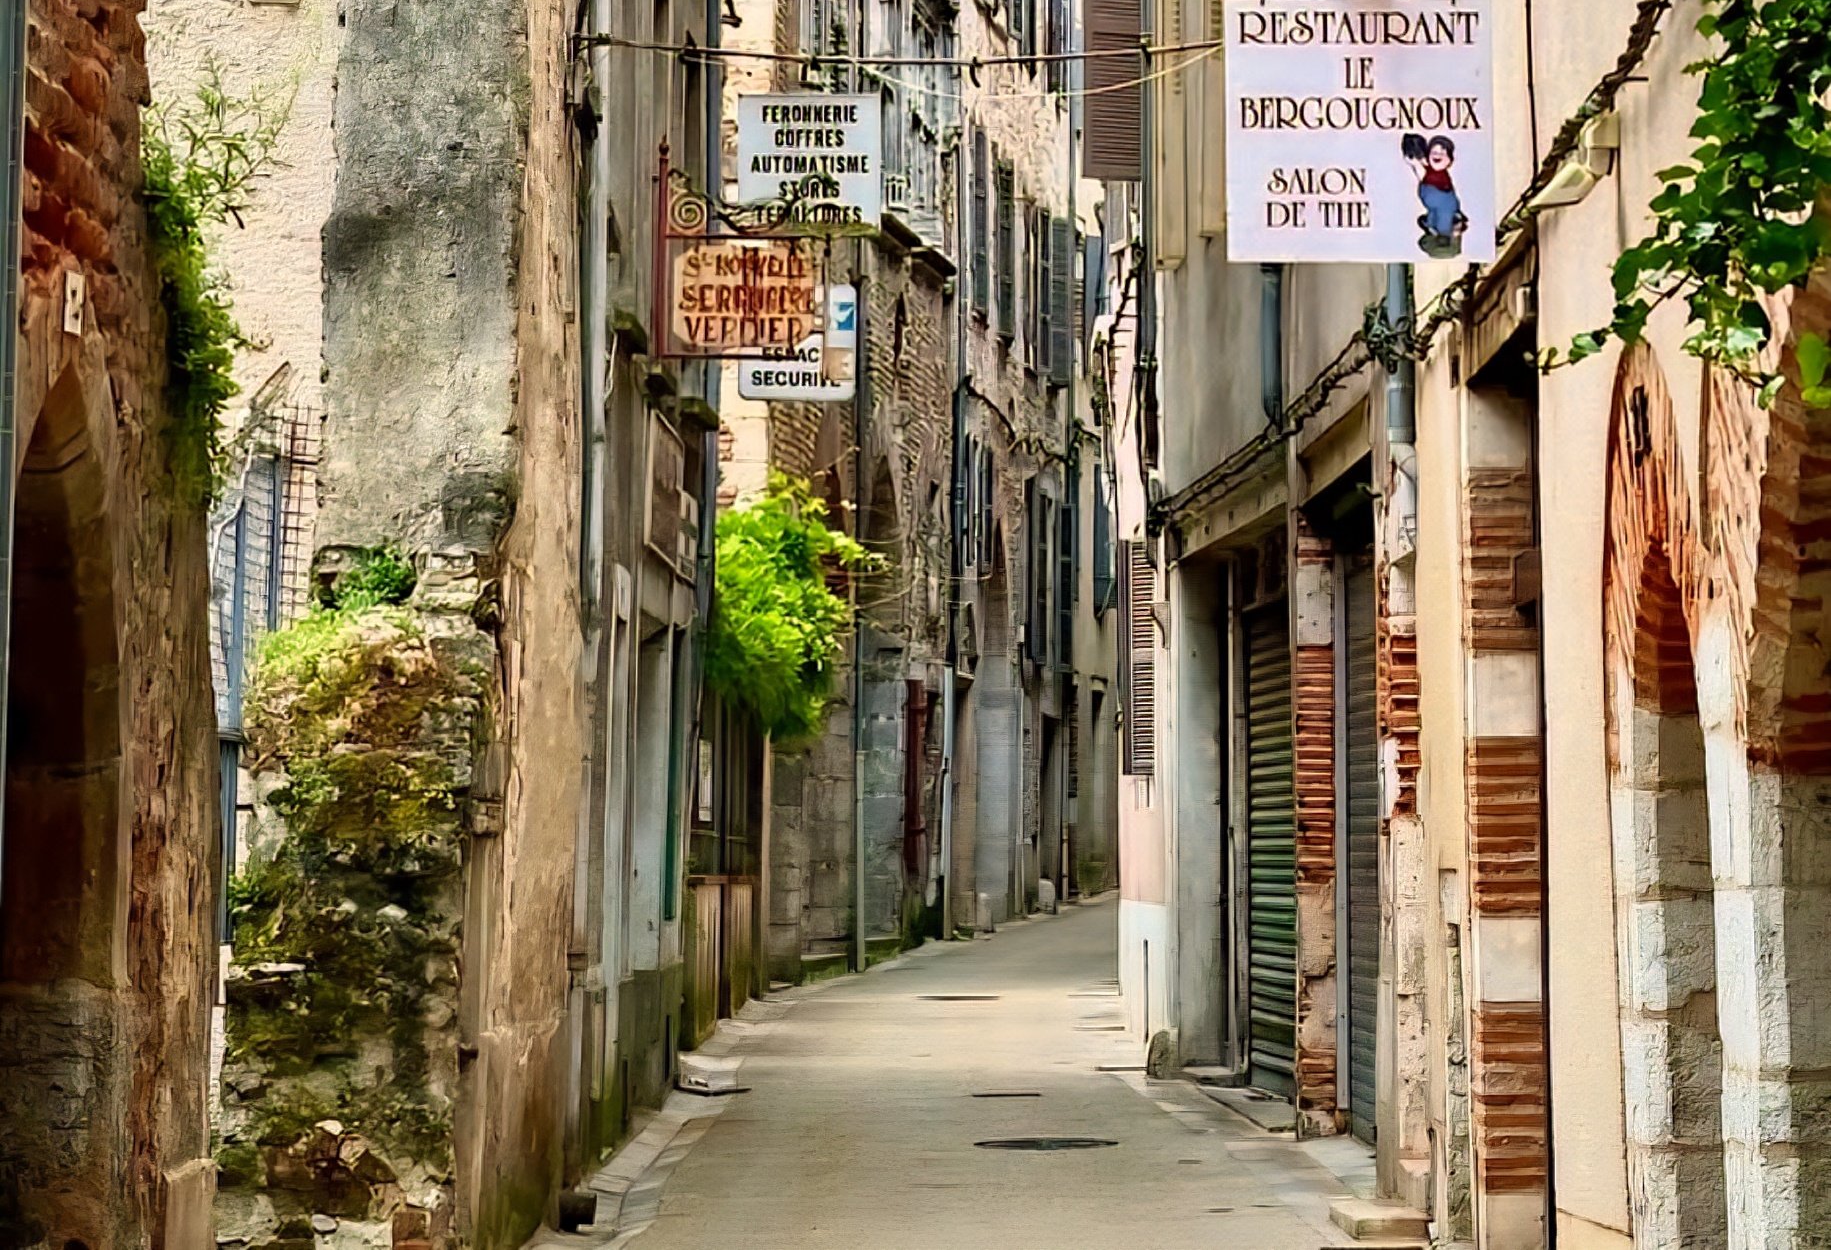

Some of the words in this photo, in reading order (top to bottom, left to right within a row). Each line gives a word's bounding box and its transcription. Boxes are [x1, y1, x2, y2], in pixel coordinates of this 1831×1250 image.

[1238, 11, 1479, 45] RESTAURANT
[1344, 56, 1375, 89] LE
[762, 104, 858, 124] FERONNERIE
[1240, 97, 1482, 130] BERGOUGNOUX
[774, 128, 845, 148] COFFRES
[751, 155, 870, 174] AUTOMATISME
[1266, 167, 1367, 195] SALON
[1266, 200, 1306, 228] DE
[1318, 200, 1370, 228] THE
